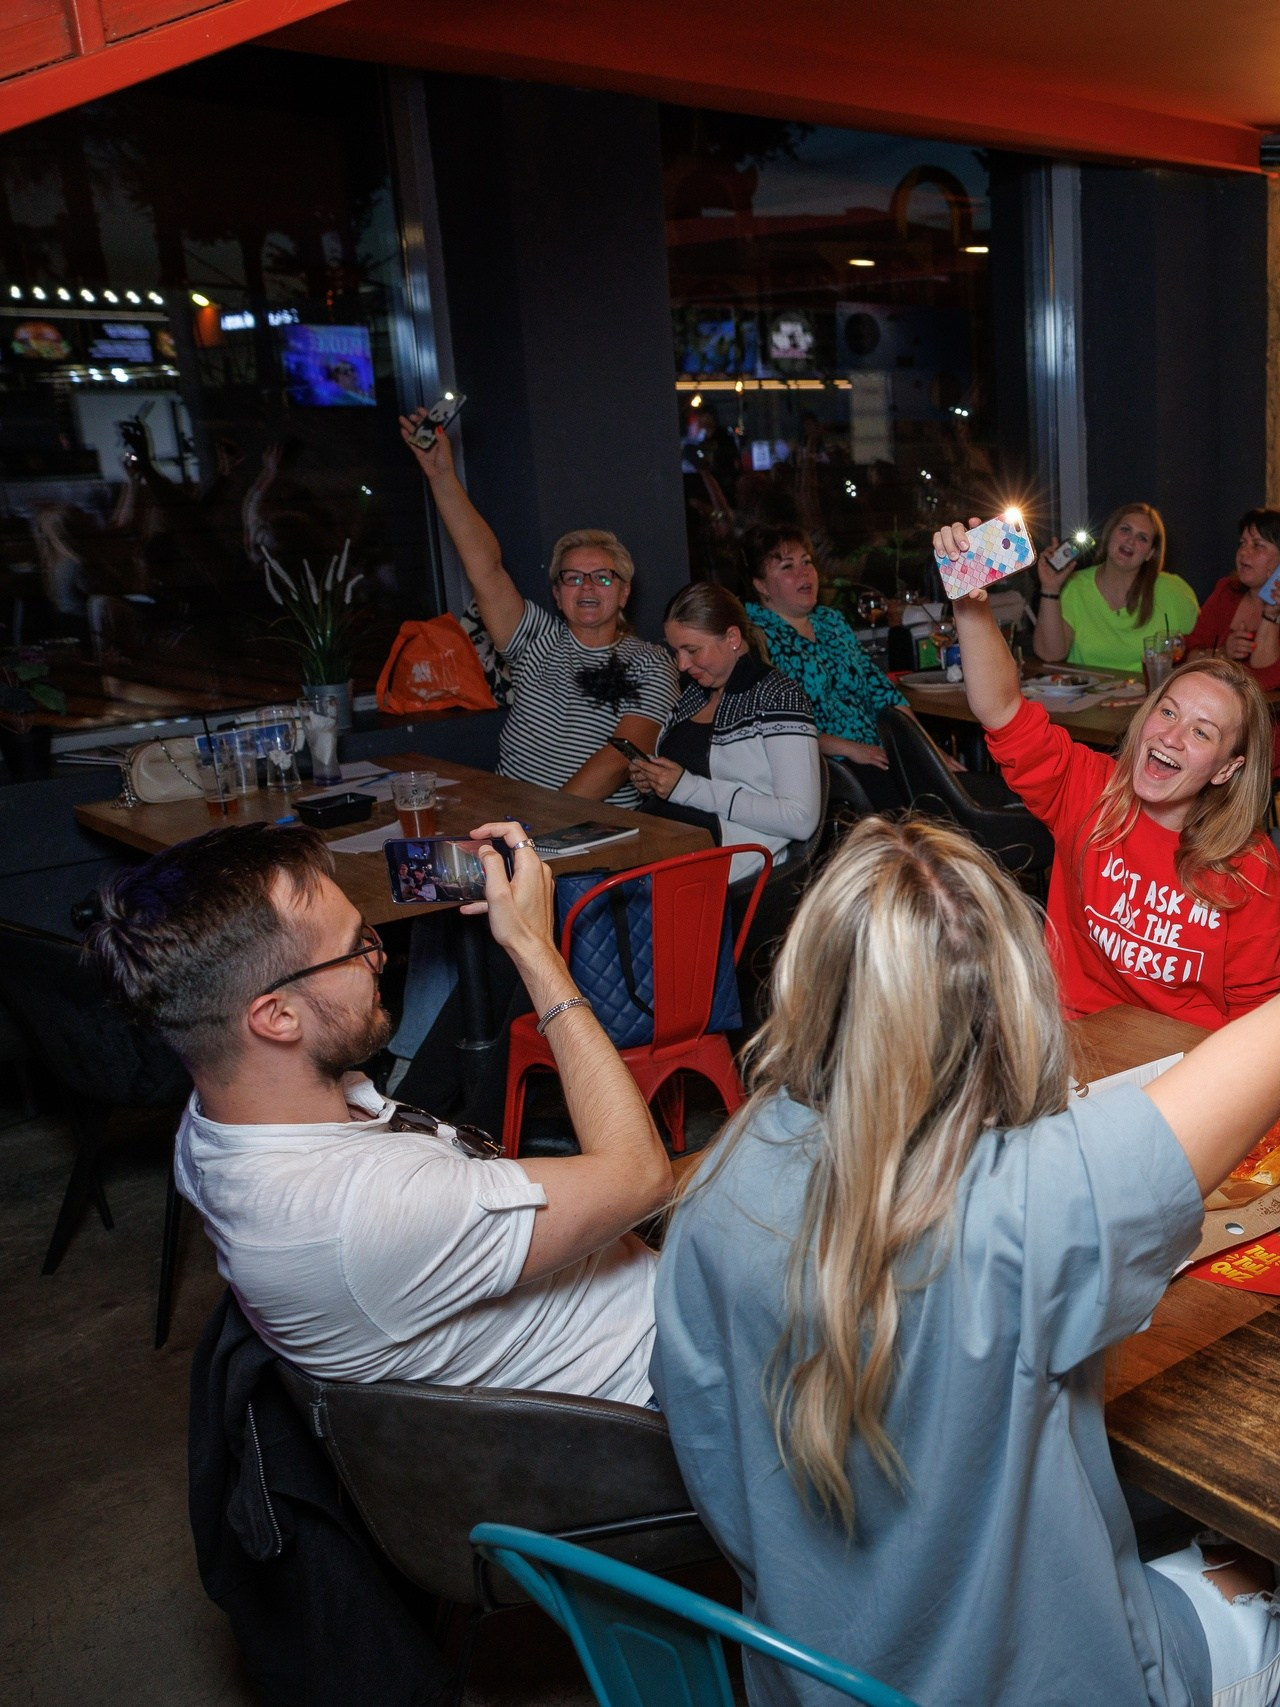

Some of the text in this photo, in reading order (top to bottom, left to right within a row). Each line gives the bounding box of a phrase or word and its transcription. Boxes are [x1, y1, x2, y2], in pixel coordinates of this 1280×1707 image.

[1110, 892, 1183, 947] ASK THE
[1144, 880, 1186, 916] ASK
[1188, 898, 1222, 929] ME
[1210, 1261, 1254, 1283] QUIZ
